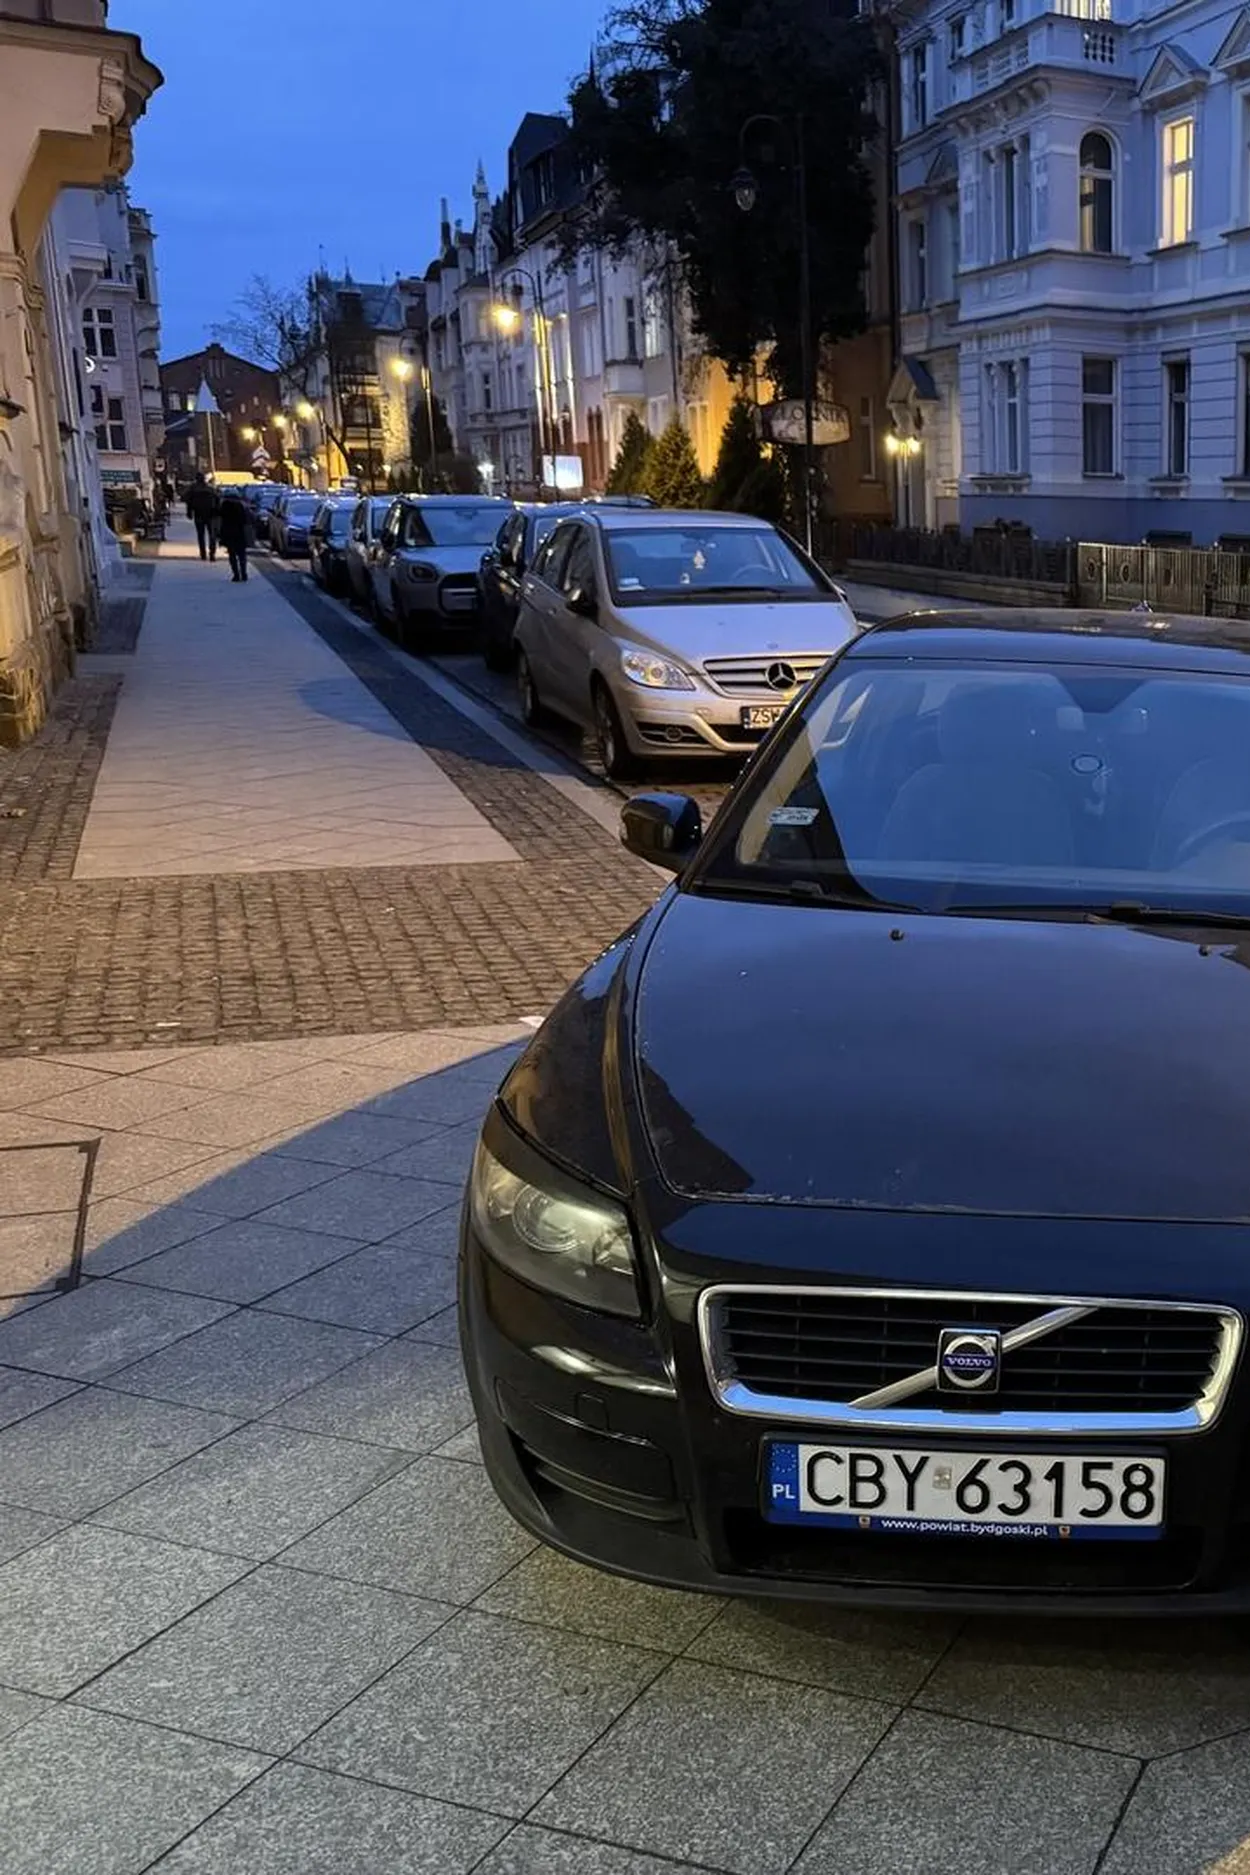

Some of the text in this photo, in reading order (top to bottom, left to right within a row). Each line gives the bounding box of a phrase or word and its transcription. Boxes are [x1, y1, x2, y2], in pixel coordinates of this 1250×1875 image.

[946, 1356, 992, 1367] VOLVO
[772, 1483, 796, 1500] PL
[806, 1450, 1156, 1519] CBY 63158
[881, 1519, 1048, 1537] www.powiat.bydgoski.pl
